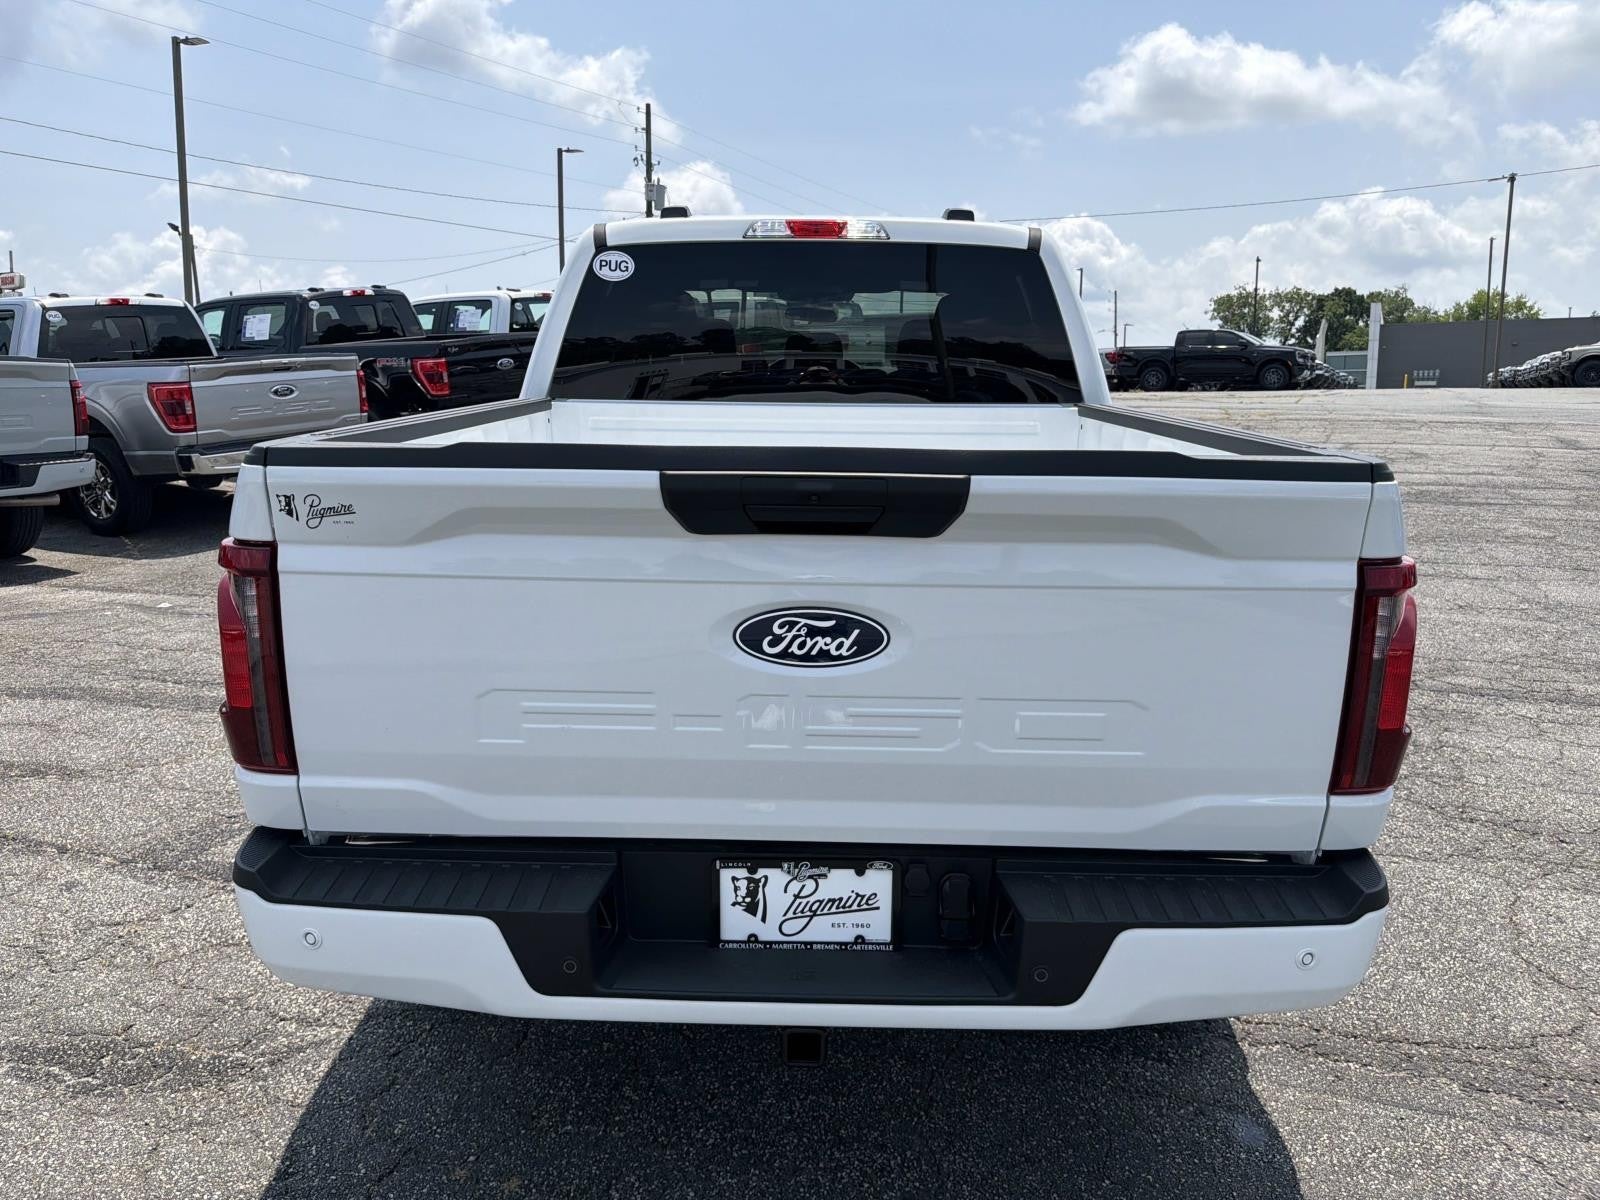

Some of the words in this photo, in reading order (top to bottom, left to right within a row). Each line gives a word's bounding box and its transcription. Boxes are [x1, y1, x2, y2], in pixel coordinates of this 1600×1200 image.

[599, 259, 630, 273] PUG
[303, 493, 356, 529] Pugmire
[762, 616, 861, 657] Ford
[778, 877, 881, 937] Pugmire
